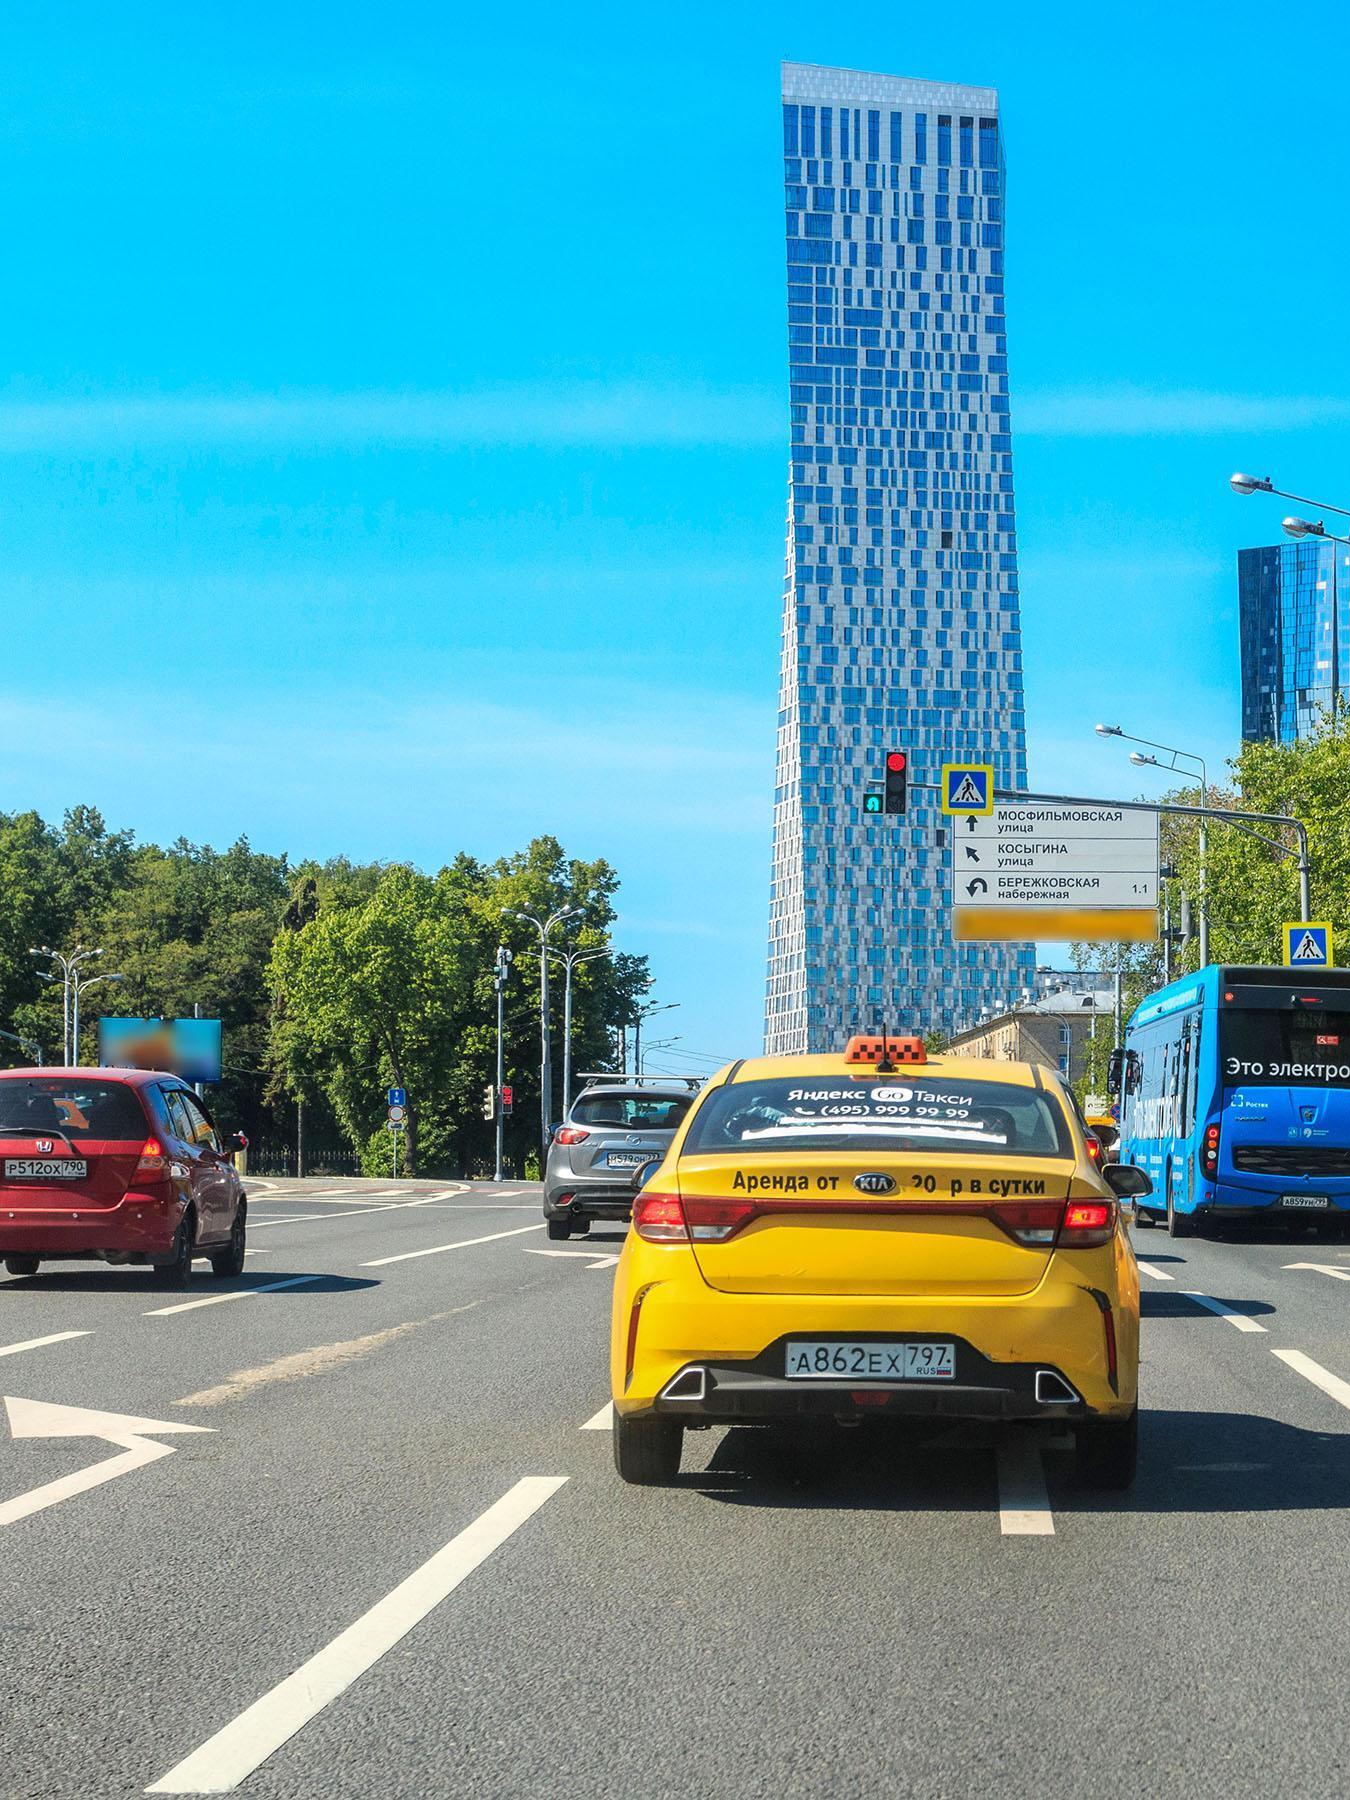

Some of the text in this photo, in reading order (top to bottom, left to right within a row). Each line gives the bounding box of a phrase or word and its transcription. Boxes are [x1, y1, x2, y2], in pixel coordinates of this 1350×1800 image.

[998, 811, 1123, 822] МОСФИЛЬМОВСКАЯ
[997, 824, 1034, 834] улица
[998, 844, 1068, 854] КОСЫГИНА
[997, 858, 1034, 868] улица
[998, 878, 1100, 887] БЕРЕЖКОВСКАЯ
[998, 889, 1070, 900] набережная
[1132, 884, 1148, 894] 1.1
[1227, 1057, 1263, 1075] Это
[787, 1089, 866, 1101] Яндекс
[914, 1090, 973, 1106] Такси
[820, 1105, 969, 1119] (495) 999 99 99
[9, 1162, 83, 1174] Р512ОХ 790
[732, 1171, 840, 1192] Аренда от
[860, 1177, 888, 1189] KIA
[950, 1178, 962, 1197] р
[970, 1180, 981, 1193] в
[989, 1178, 1045, 1197] сутки
[796, 1346, 947, 1372] А862ЕХ 797
[916, 1367, 936, 1375] RUS
